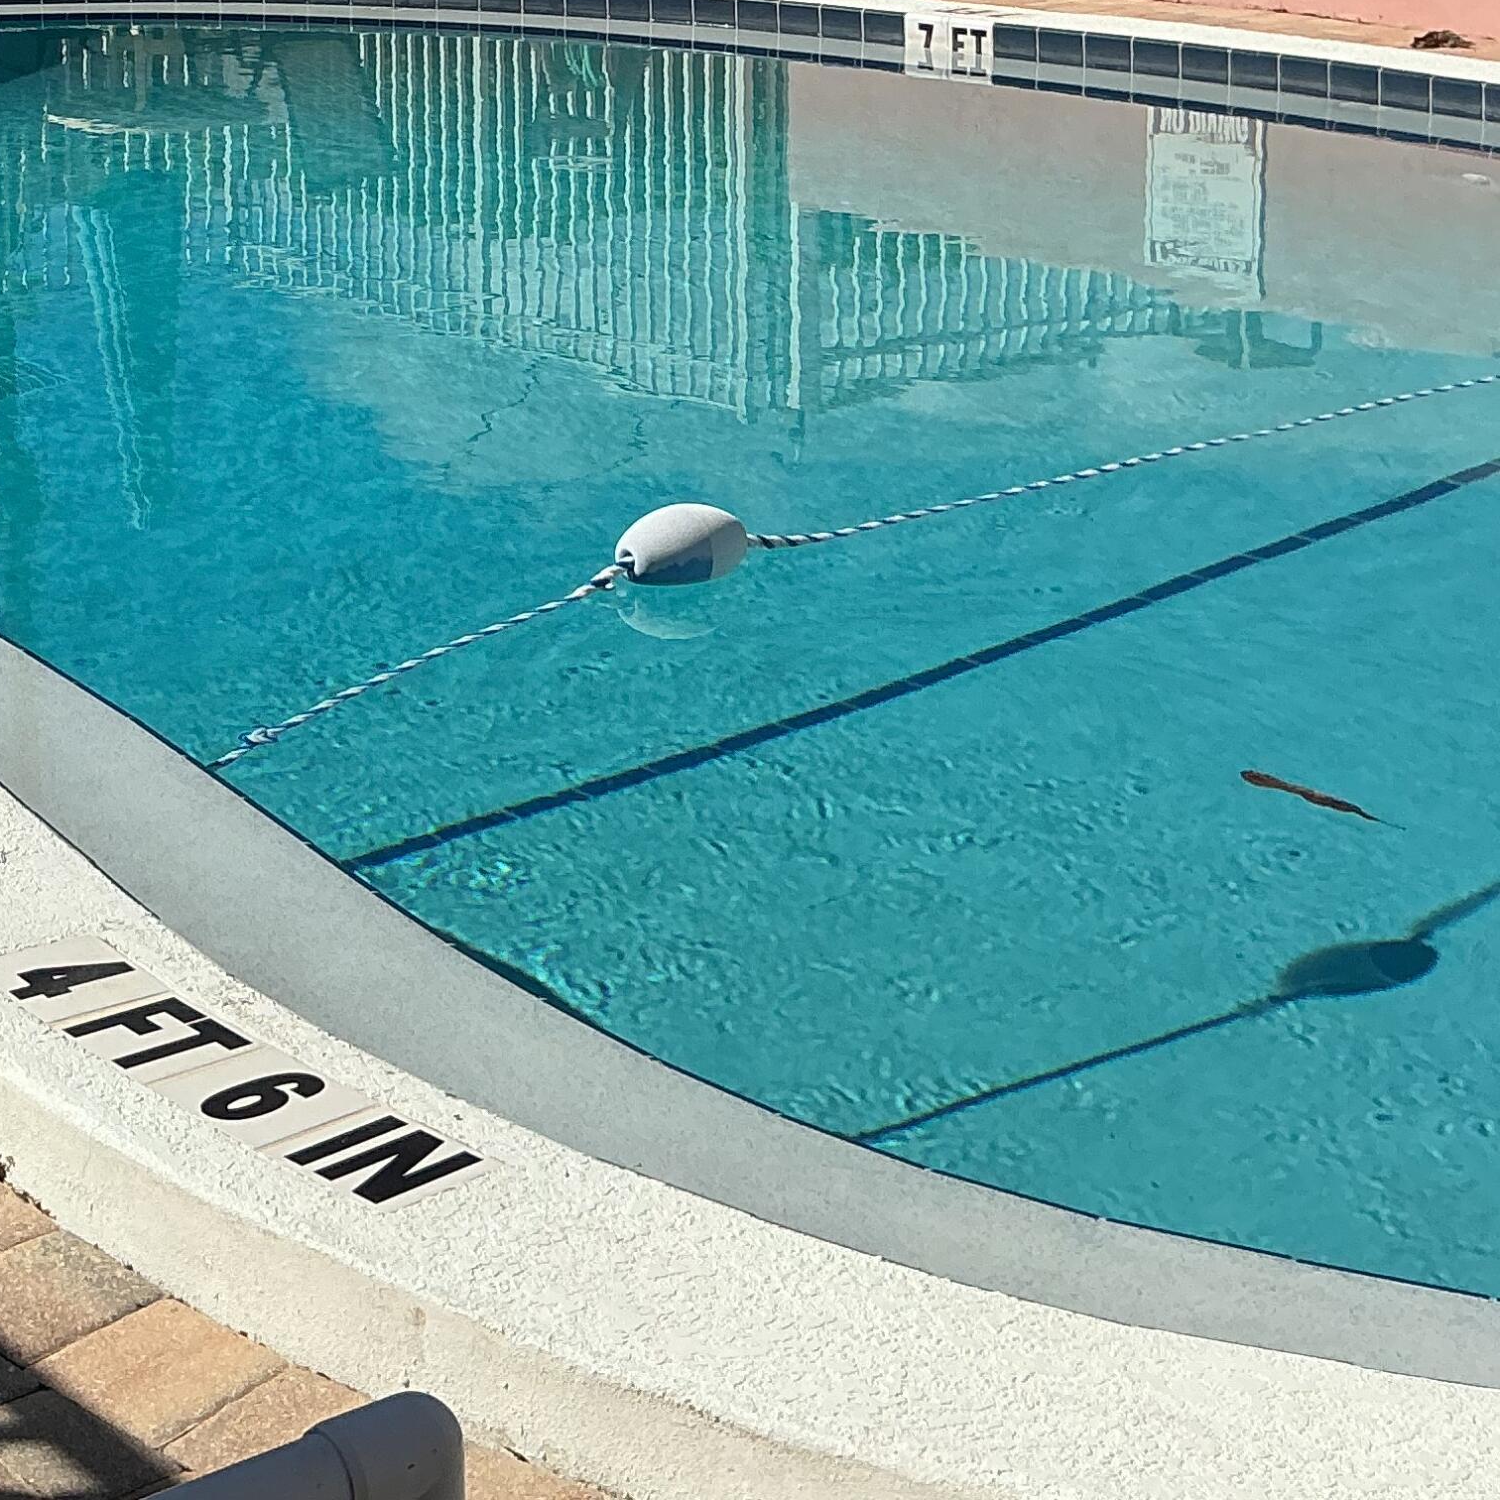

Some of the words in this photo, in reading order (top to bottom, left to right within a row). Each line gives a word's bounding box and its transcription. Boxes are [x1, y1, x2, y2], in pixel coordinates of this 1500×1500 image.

[918, 23, 933, 48] 7
[952, 27, 987, 54] FT
[10, 961, 135, 1000] 4
[63, 997, 253, 1069] FT
[200, 1072, 325, 1120] 6
[285, 1115, 484, 1205] IN
